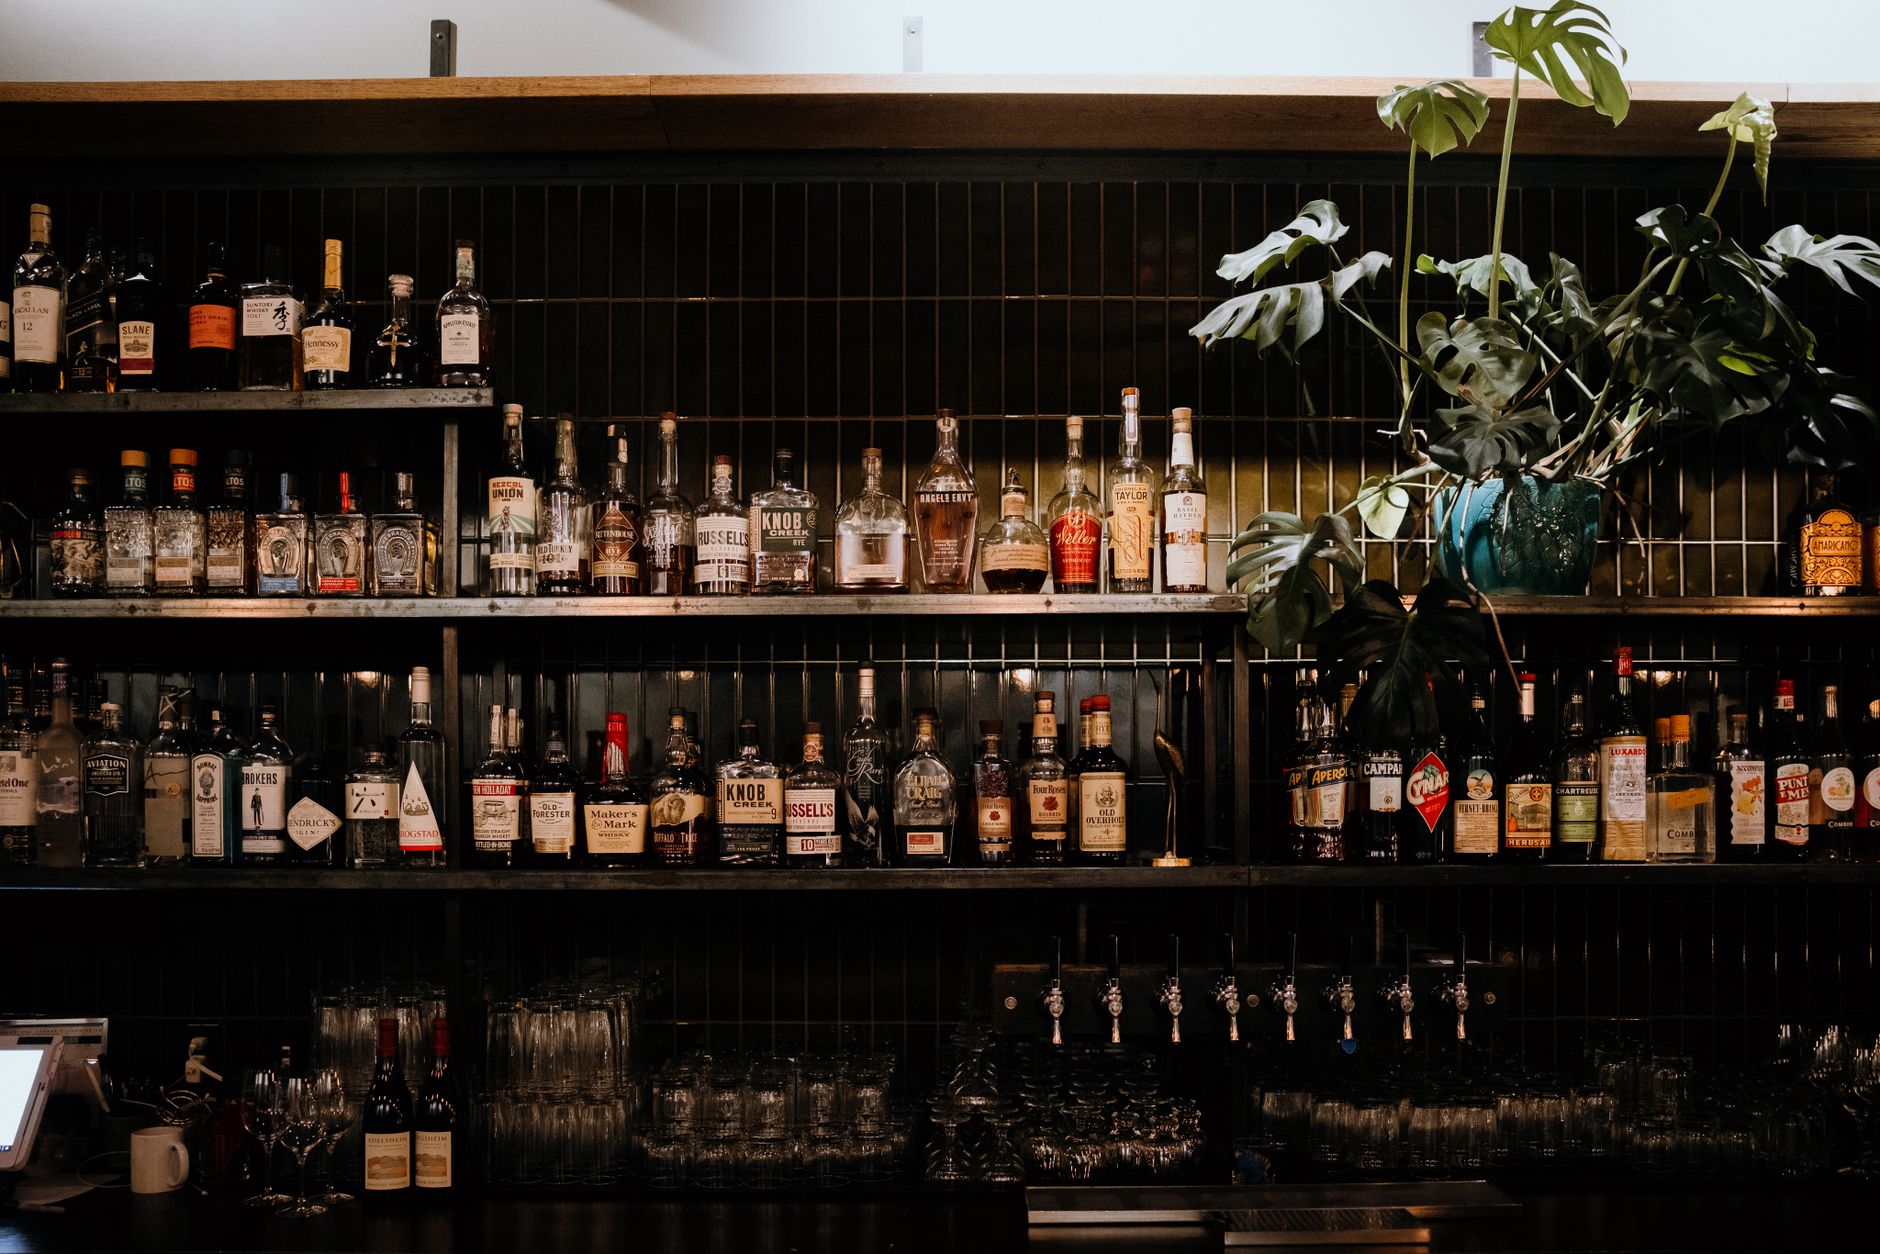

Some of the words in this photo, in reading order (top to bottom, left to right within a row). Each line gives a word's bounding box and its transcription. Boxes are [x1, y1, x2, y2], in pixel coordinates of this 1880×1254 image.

[22, 322, 33, 331] 12
[122, 325, 151, 336] SLANE
[305, 339, 340, 351] Hennessy
[125, 477, 147, 488] LTOS
[173, 477, 195, 488] LTOS
[225, 477, 245, 486] LTOS
[492, 489, 523, 499] UNION
[952, 493, 973, 503] ENVY
[1115, 491, 1148, 501] TAYLOR
[762, 511, 802, 531] KNOB
[698, 530, 749, 547] RUSSELL'S
[769, 529, 810, 537] CREEK
[1055, 526, 1098, 546] Weller
[792, 538, 805, 547] RYE
[1813, 540, 1859, 551] AMARICANO
[86, 759, 126, 769] AVIATION
[196, 761, 217, 773] BOMBAY
[1363, 762, 1403, 775] CAMPAR
[11, 777, 29, 788] One
[1406, 770, 1450, 806] CYNAR
[1776, 776, 1808, 791] PUNT
[482, 785, 512, 795] HOLLADAY
[726, 784, 766, 801] KNOB
[906, 786, 943, 800] CRAIG
[1033, 785, 1048, 796] Four
[1048, 785, 1067, 796] Roses
[771, 808, 778, 820] 9
[1099, 809, 1116, 817] OLD
[1458, 803, 1498, 814] FERNET-BRAN
[532, 811, 570, 819] FORESTER
[591, 811, 638, 820] Maker's
[288, 819, 336, 828] ENDRICK'S
[603, 820, 638, 830] Mark
[399, 830, 440, 838] ROGSTAD
[475, 841, 512, 849] TTLED-IN-BOND
[802, 839, 813, 851] 10
[368, 1136, 409, 1144] ADELSHEIM
